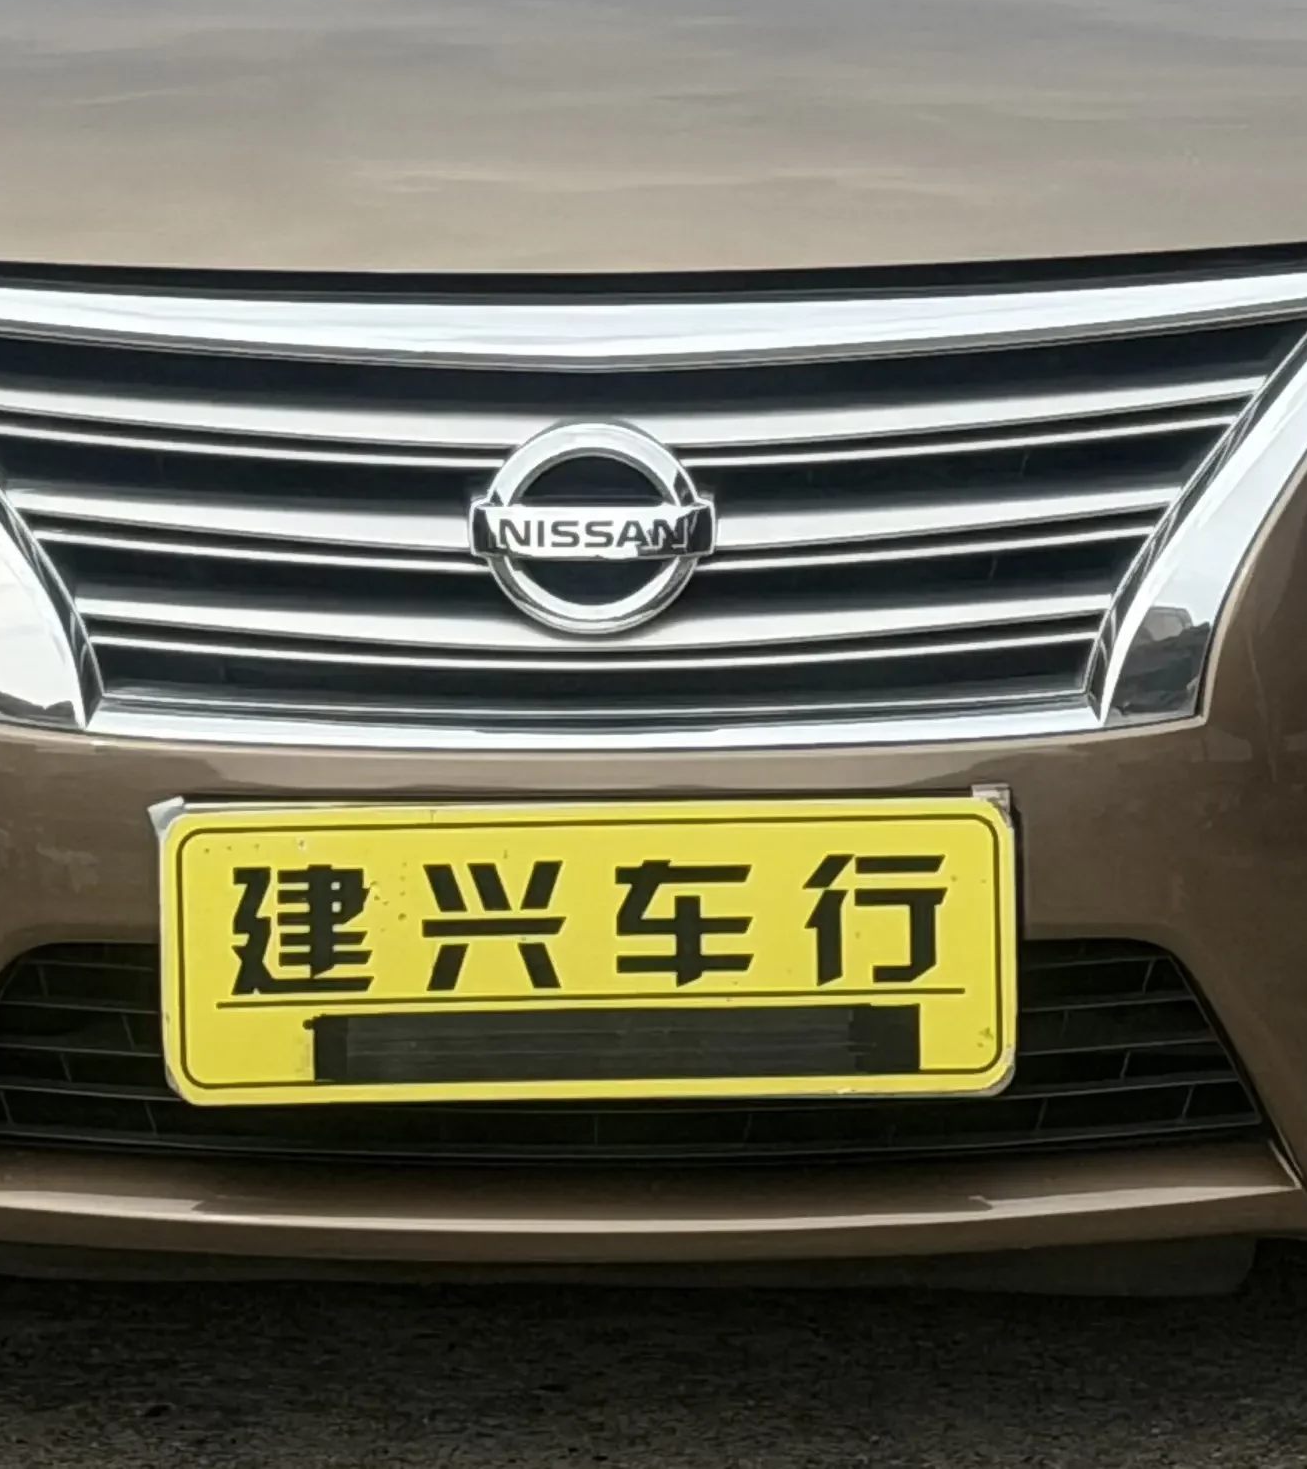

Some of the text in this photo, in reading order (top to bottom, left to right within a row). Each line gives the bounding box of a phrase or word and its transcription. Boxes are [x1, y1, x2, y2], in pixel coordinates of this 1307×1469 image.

[498, 517, 689, 549] NISSAN
[230, 852, 948, 996] 建兴车行
